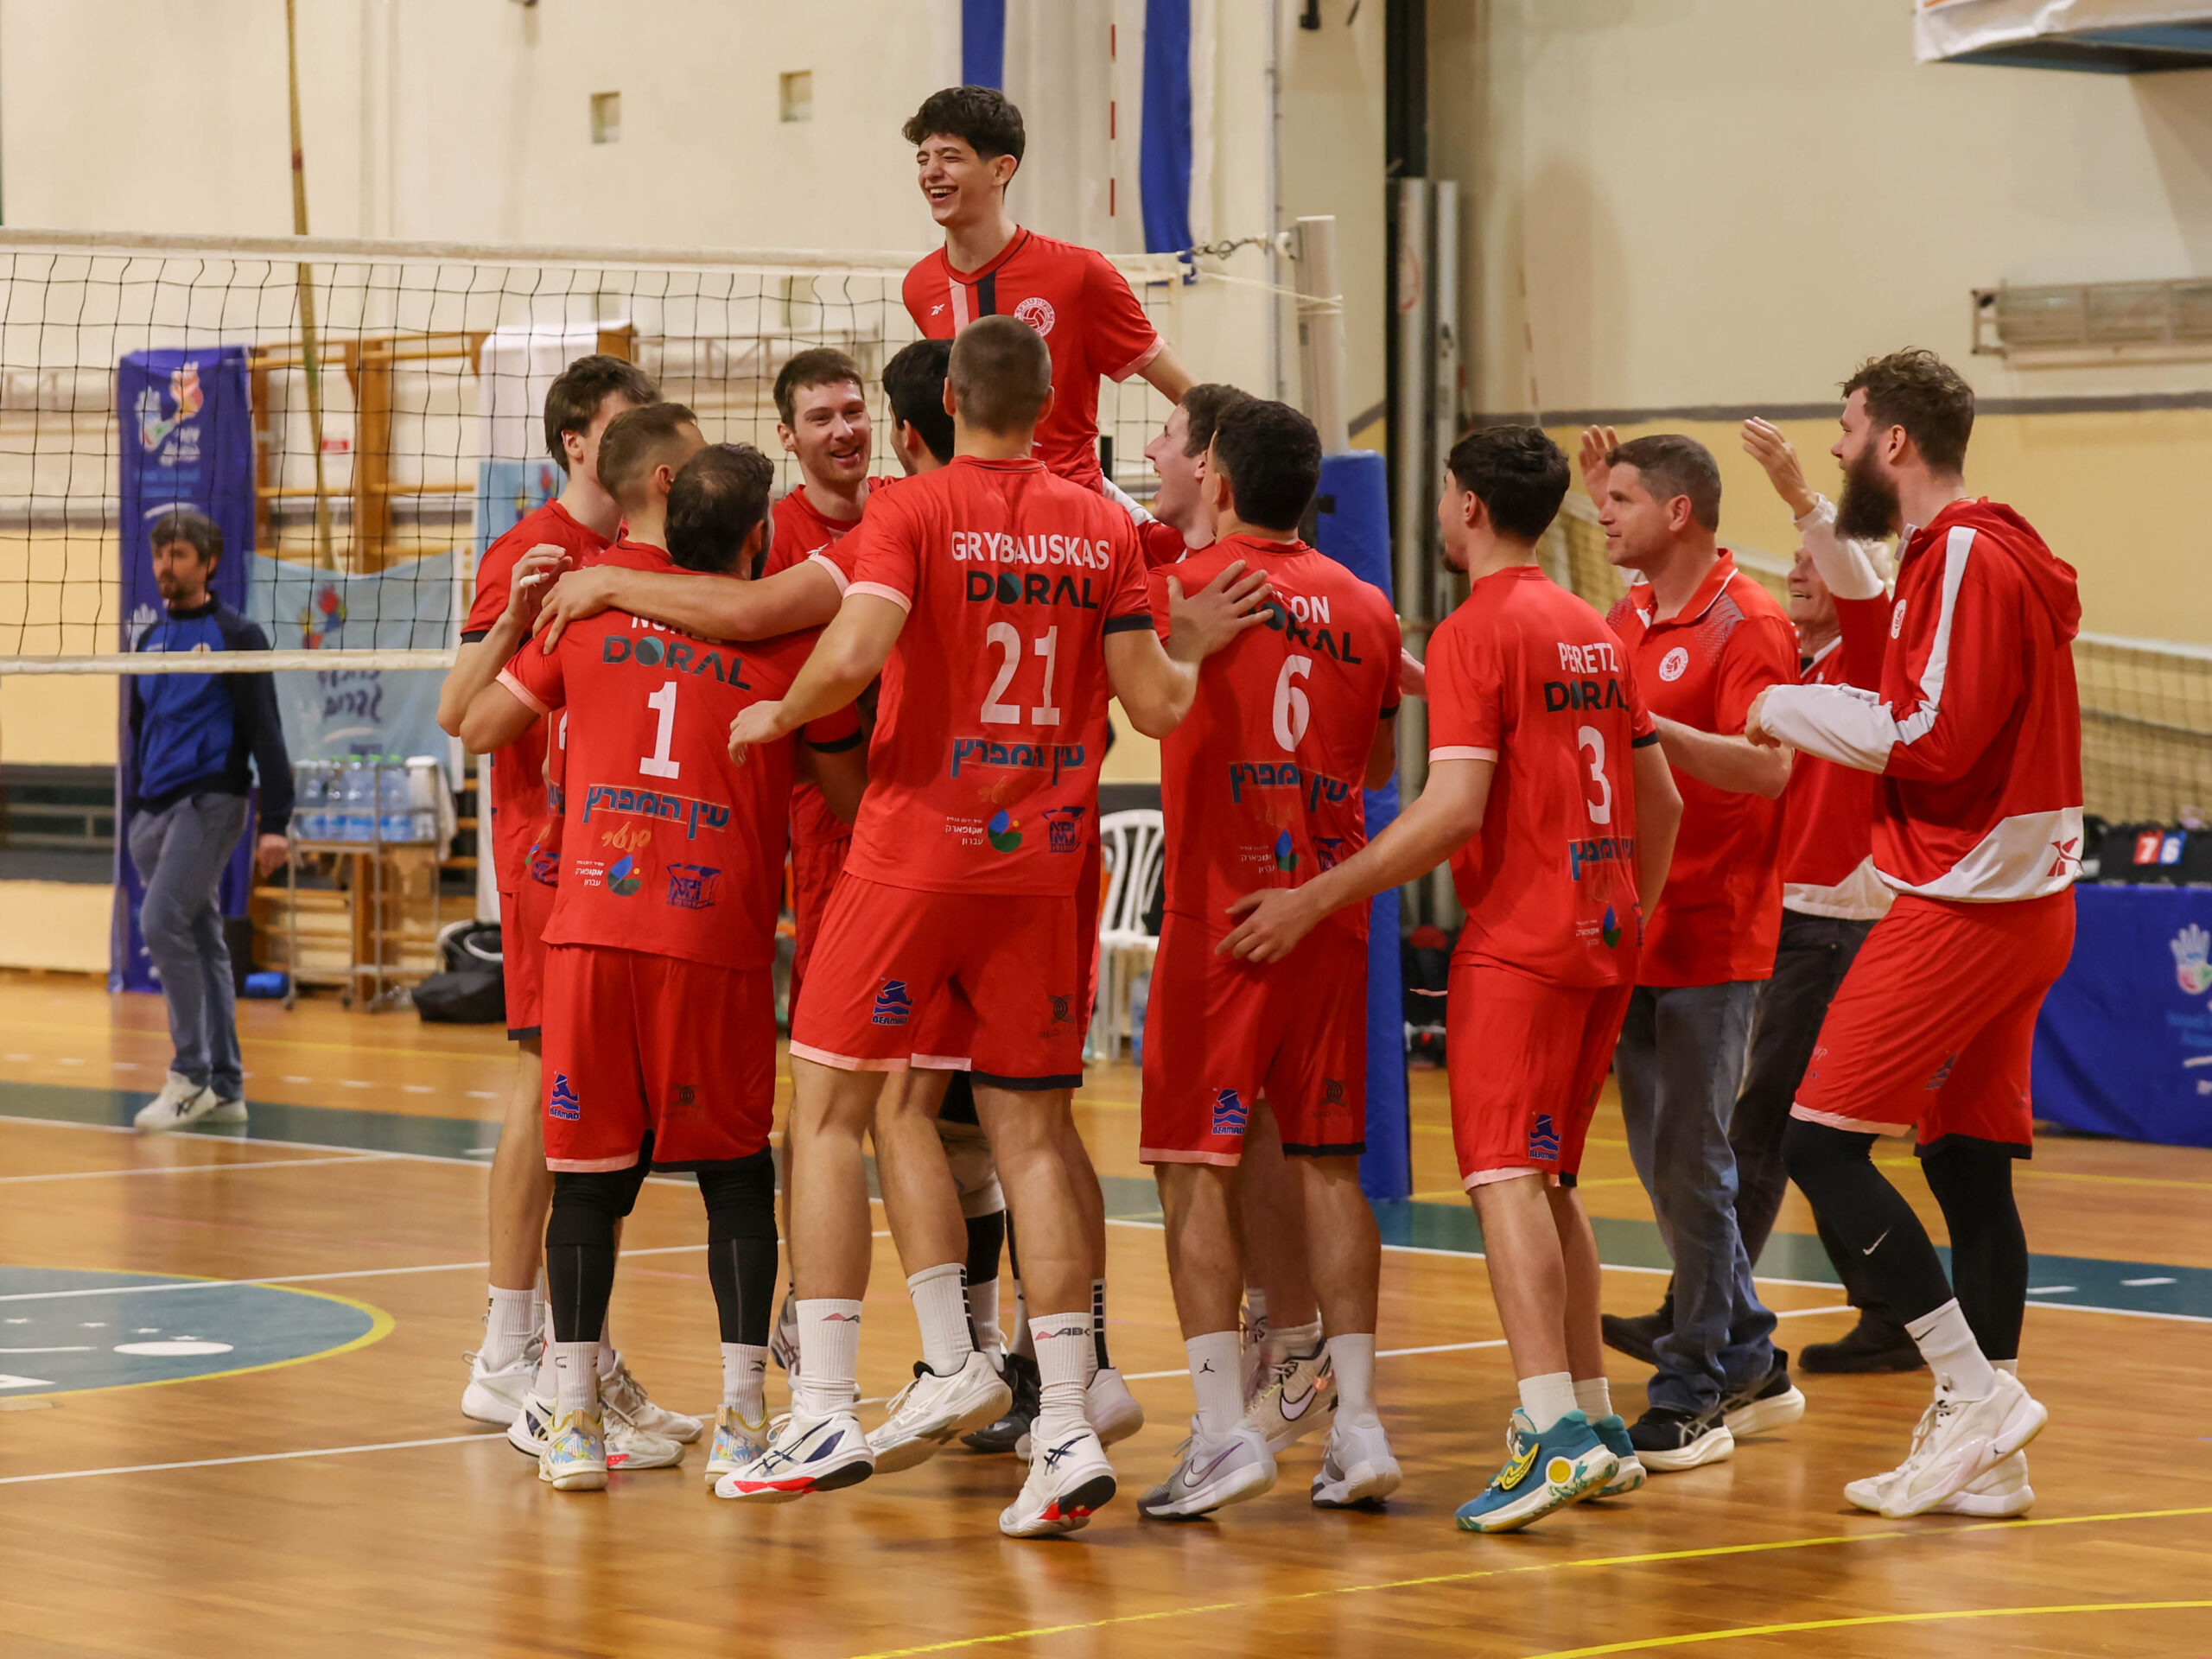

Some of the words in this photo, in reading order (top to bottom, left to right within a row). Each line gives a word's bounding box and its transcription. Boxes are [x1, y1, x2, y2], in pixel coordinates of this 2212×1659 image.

[951, 531, 1110, 570] GRYBAUSKAS
[966, 570, 1099, 609] DORAL
[1247, 601, 1363, 665] ORAL
[602, 634, 752, 691] DORAL
[980, 621, 1060, 726] 21
[1556, 642, 1620, 674] PERETZ
[1272, 653, 1313, 753] 6
[639, 681, 681, 779] 1
[1052, 744, 1086, 786] עין
[1229, 762, 1305, 804] מפרץ
[1578, 725, 1612, 825] 3
[582, 786, 683, 823] המפרץ
[1308, 774, 1350, 812] עין
[687, 800, 730, 840] עין
[549, 1107, 581, 1121] BERMAD
[1211, 1126, 1244, 1135] BERMAD
